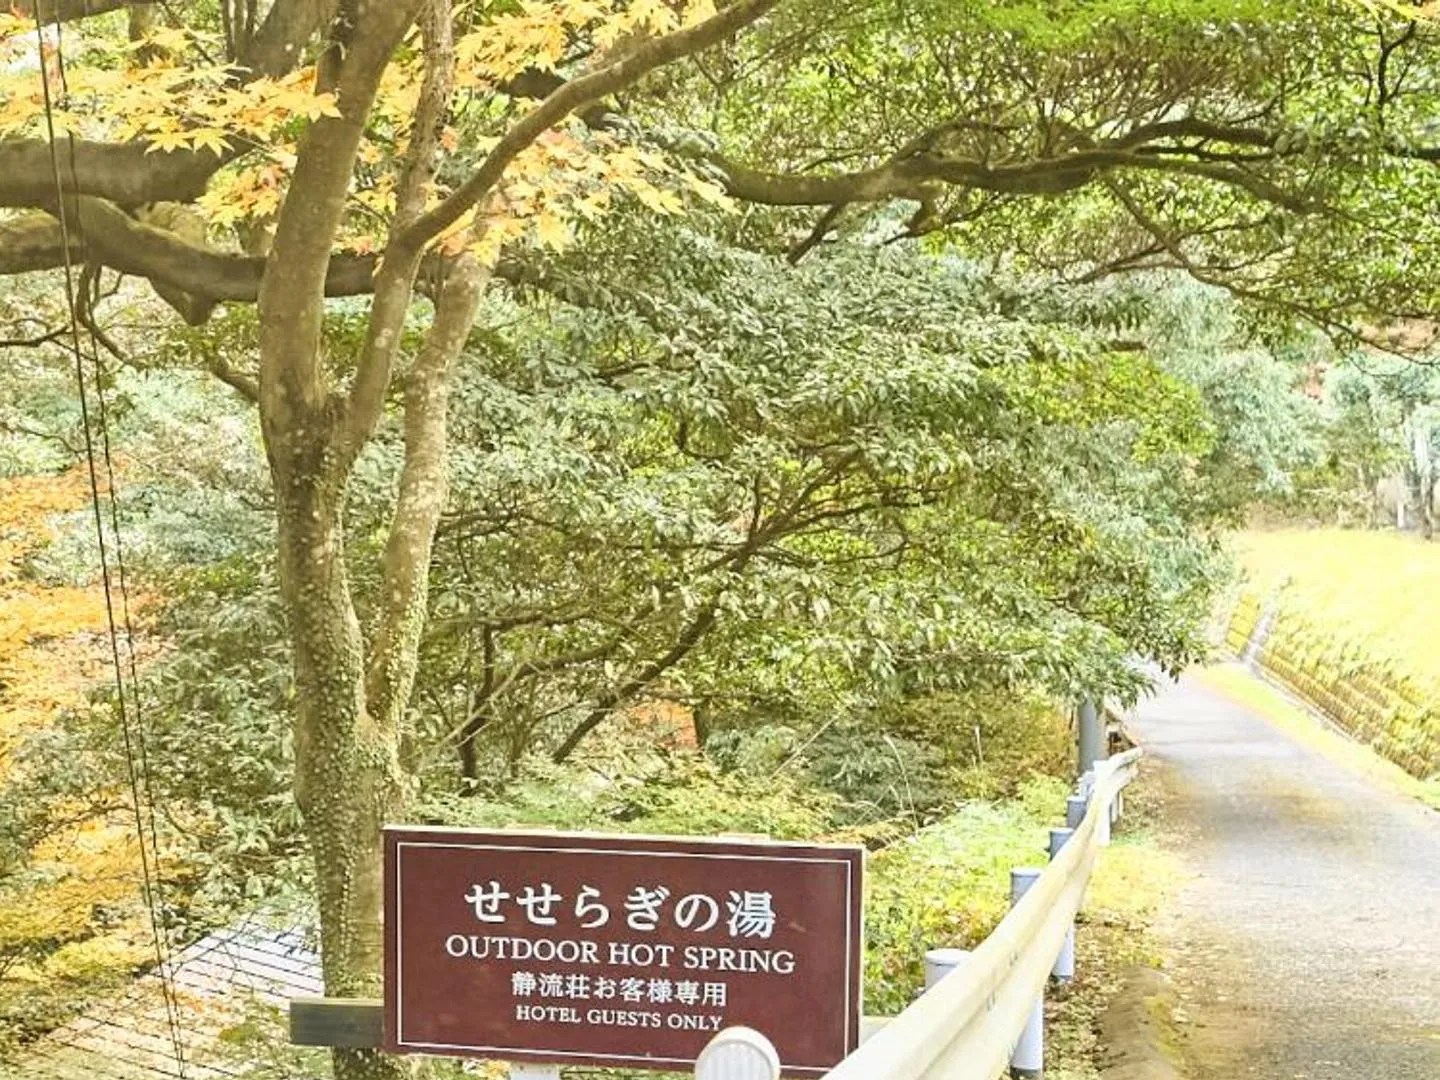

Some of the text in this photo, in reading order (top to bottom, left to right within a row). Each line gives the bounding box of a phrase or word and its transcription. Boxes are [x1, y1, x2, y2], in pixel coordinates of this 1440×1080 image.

[464, 880, 776, 939] せせらぎの湯
[445, 934, 795, 974] OUTDOOR HOT SPRING
[511, 971, 726, 1007] 静流荘お客様専用
[515, 1004, 723, 1032] HOTEL GUESTS ONLY
